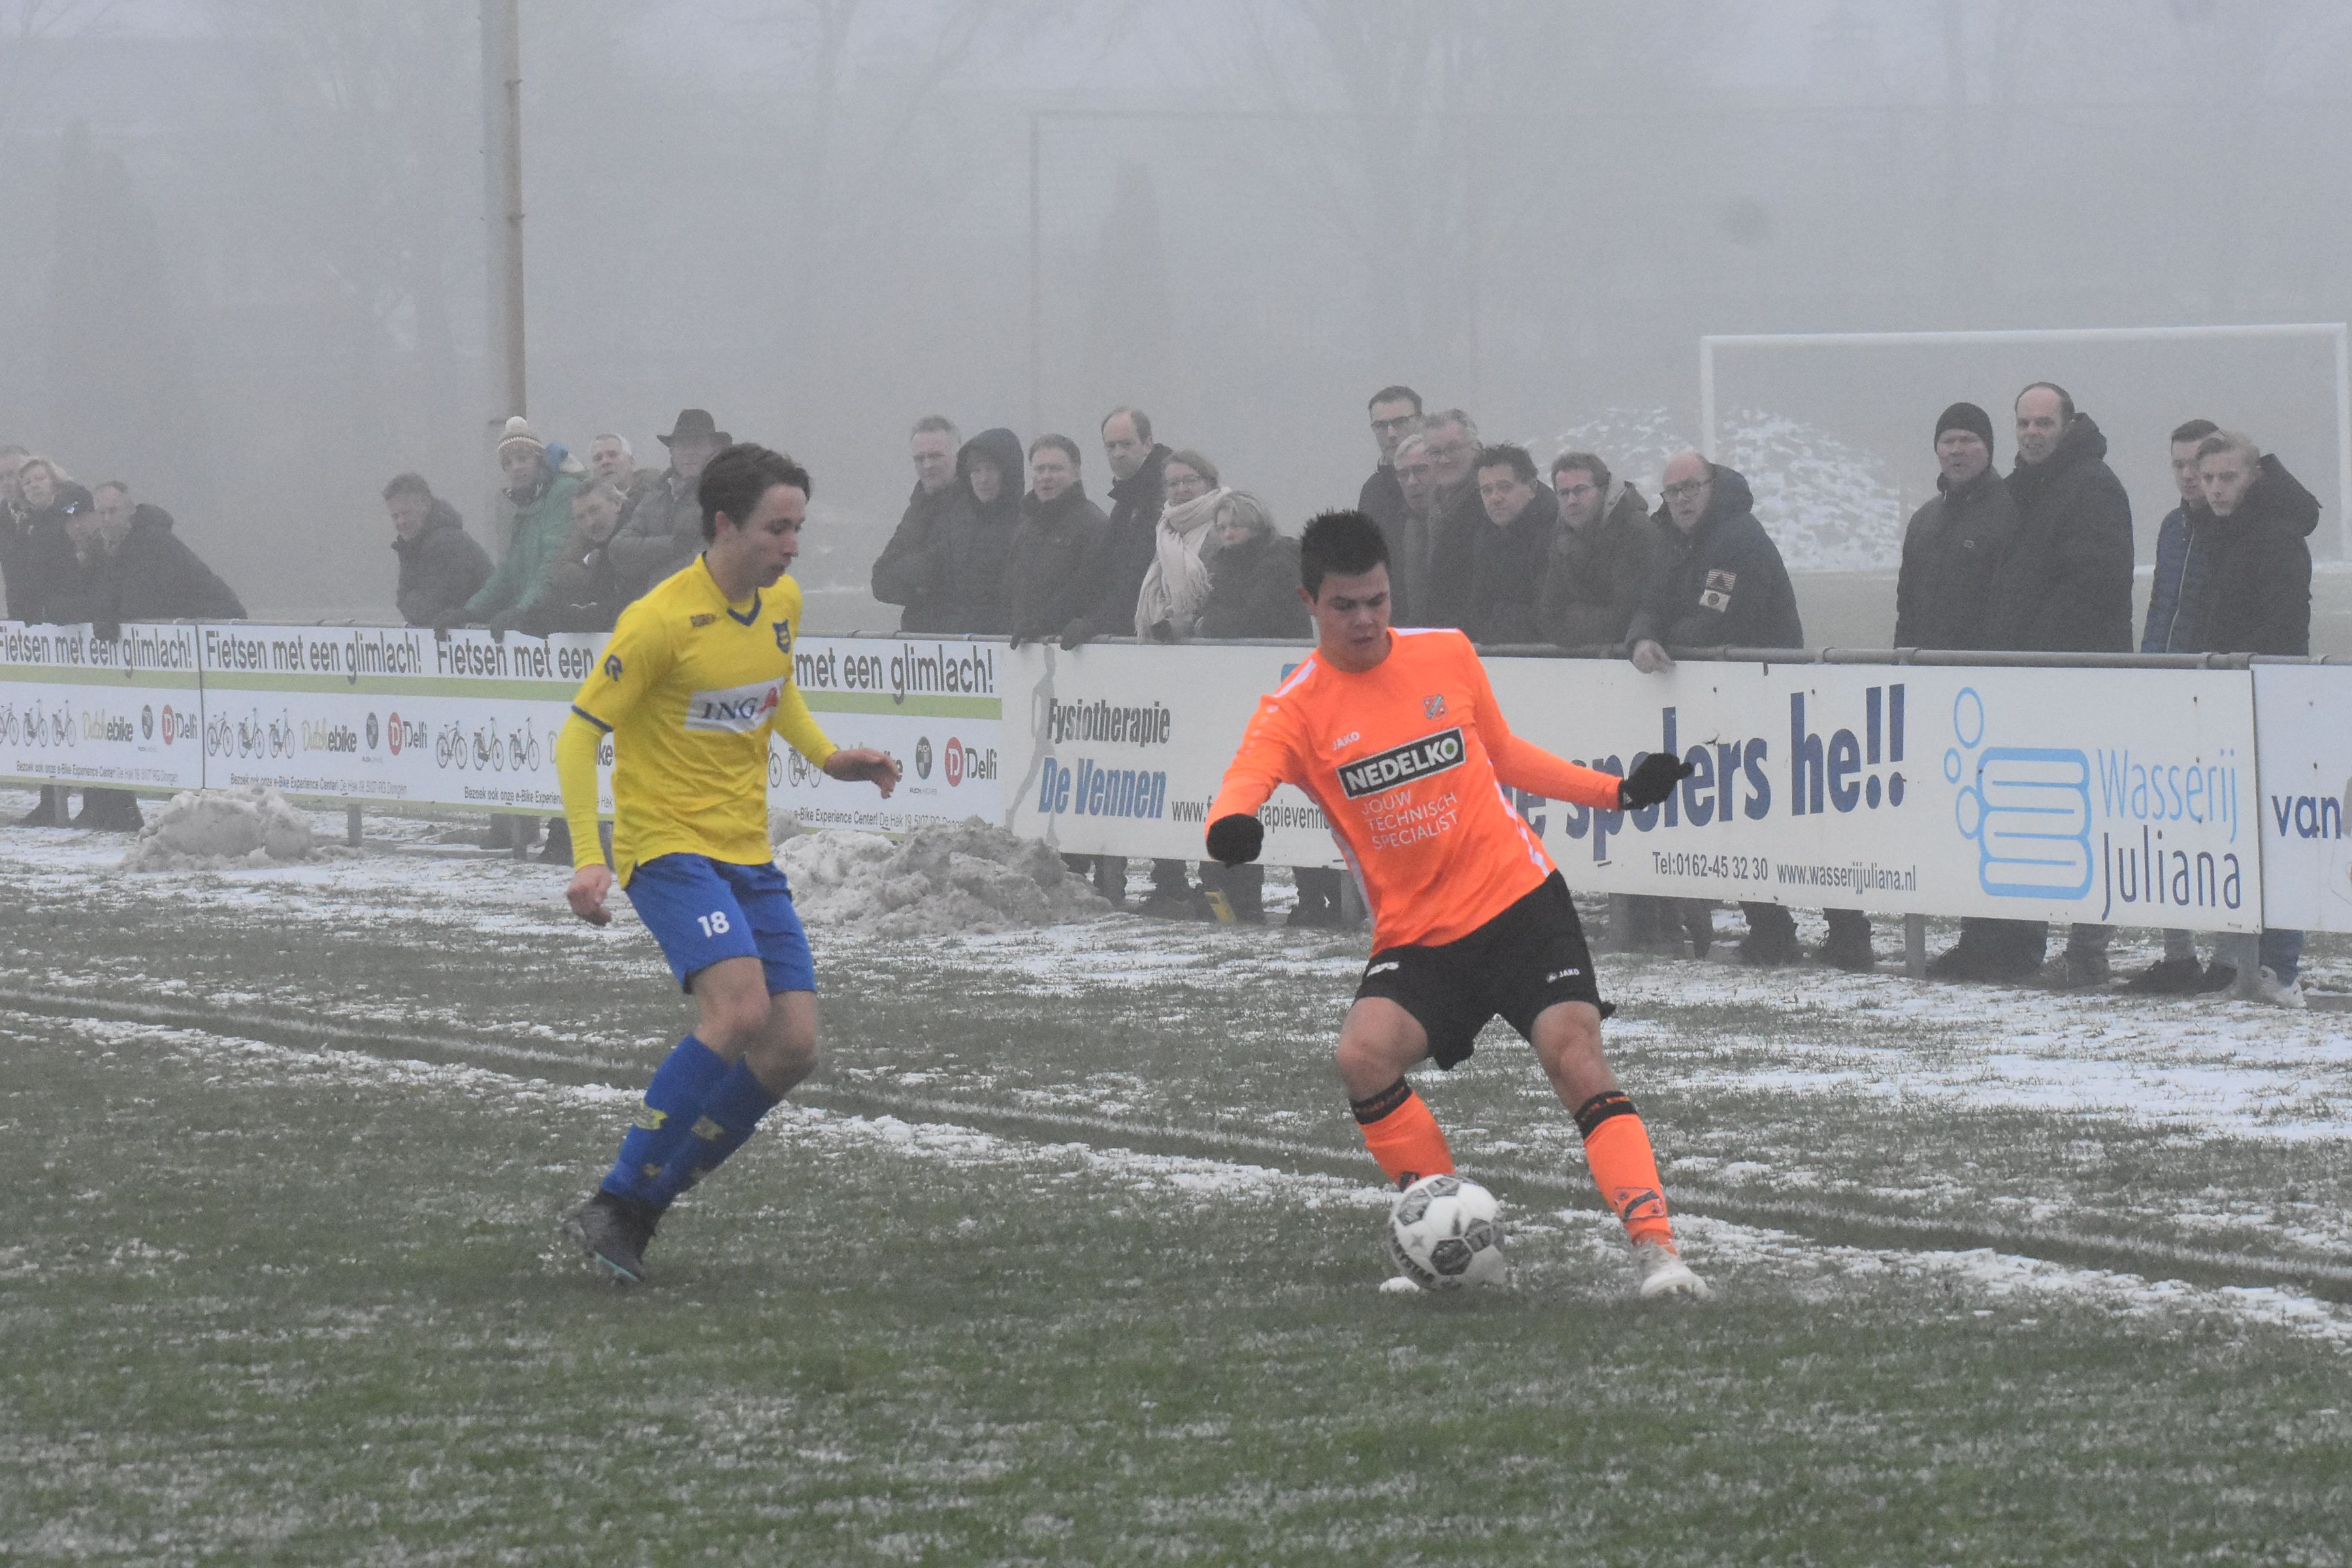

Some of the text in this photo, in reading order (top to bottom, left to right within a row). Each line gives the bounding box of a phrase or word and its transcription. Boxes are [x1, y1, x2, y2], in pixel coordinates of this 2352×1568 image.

[55, 631, 85, 664] met
[90, 638, 118, 665] een
[123, 627, 191, 679] glimlach!
[206, 630, 421, 685] Fietsen met een glimlach!
[436, 634, 595, 679] Fietsen met een
[795, 643, 994, 704] met een glimlach!
[175, 712, 198, 740] Delfi
[701, 697, 758, 720] ING
[1047, 698, 1170, 747] Fysiotherapie
[403, 721, 428, 749] Delfi
[1333, 731, 1360, 751] JAKO
[1790, 683, 1905, 816] he!!
[965, 747, 997, 779] Delfi
[1346, 738, 1458, 791] NEDELKO
[465, 786, 486, 800] Bezoek
[488, 788, 499, 800] ook
[500, 790, 515, 802] onze
[516, 789, 534, 803] e-Bike
[1038, 757, 1166, 819] De Vennen
[1362, 789, 1411, 815] JOUW
[2098, 748, 2238, 843] Wasserij
[816, 808, 852, 827] Experience
[855, 810, 878, 826] Center!
[879, 813, 889, 826] De
[890, 813, 903, 828] Hak
[1365, 791, 1458, 832] TECHNISCH
[1372, 809, 1458, 850] SPECIALIST
[2271, 795, 2342, 840] van
[1652, 851, 1768, 880] Tel:0162-45 32 30
[1777, 862, 1916, 894] www.wasserijjuliana.nl
[2101, 825, 2241, 921] Juliana
[698, 911, 730, 938] 18
